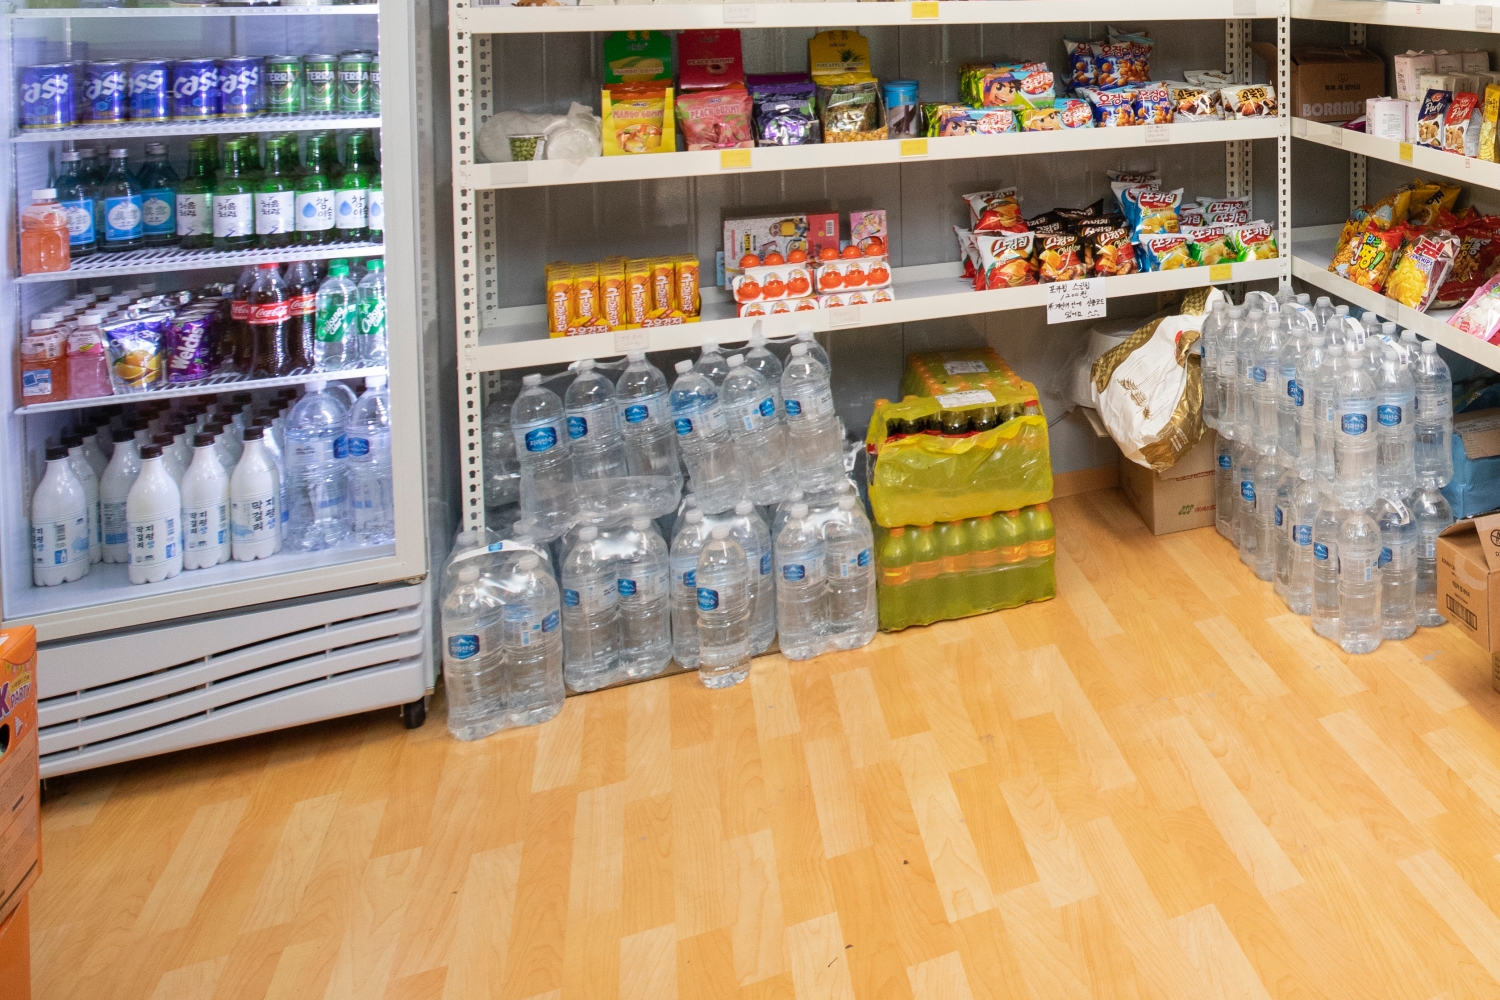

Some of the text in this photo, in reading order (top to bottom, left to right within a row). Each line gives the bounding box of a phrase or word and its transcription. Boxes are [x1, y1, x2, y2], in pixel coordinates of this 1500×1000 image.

[689, 106, 741, 120] PEACH GUMMY
[1425, 100, 1444, 113] Party
[1344, 420, 1366, 430] 지리산수
[252, 501, 263, 531] 막걸리
[265, 497, 275, 530] 지평생
